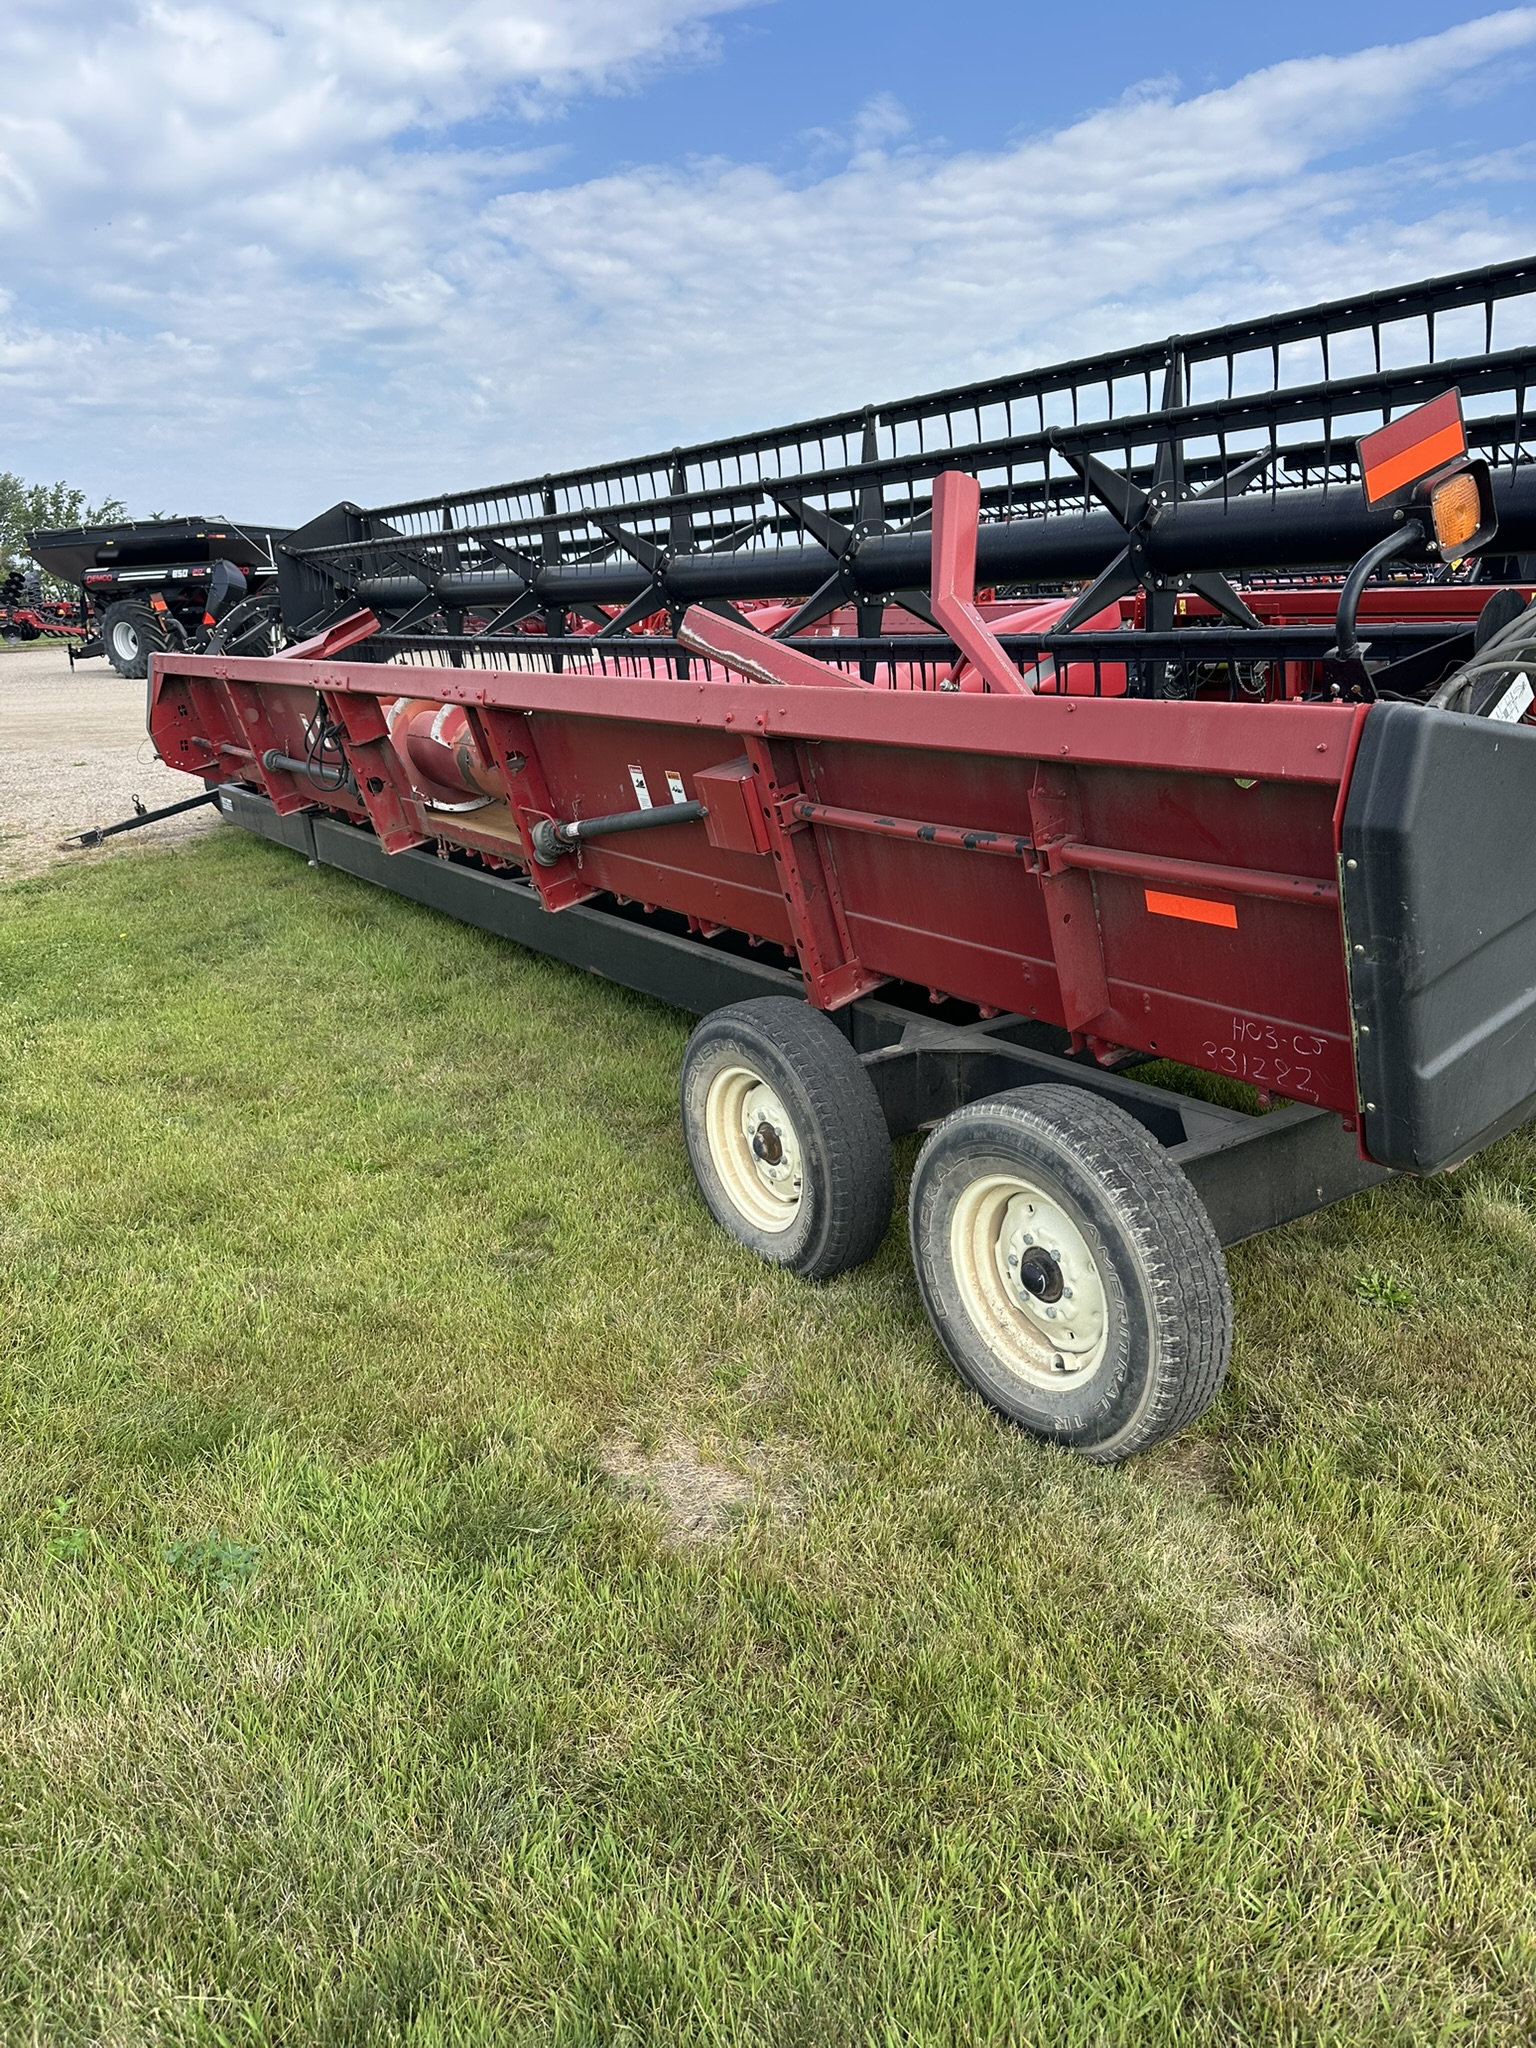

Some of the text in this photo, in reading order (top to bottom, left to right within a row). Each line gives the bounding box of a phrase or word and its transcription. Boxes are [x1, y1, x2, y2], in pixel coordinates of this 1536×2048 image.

[86, 573, 113, 584] DEMCO
[172, 568, 189, 579] 850
[685, 1038, 753, 1110] GENERAL
[920, 1152, 967, 1318] GENERAL
[1054, 1221, 1130, 1432] AMERITRAC TR
